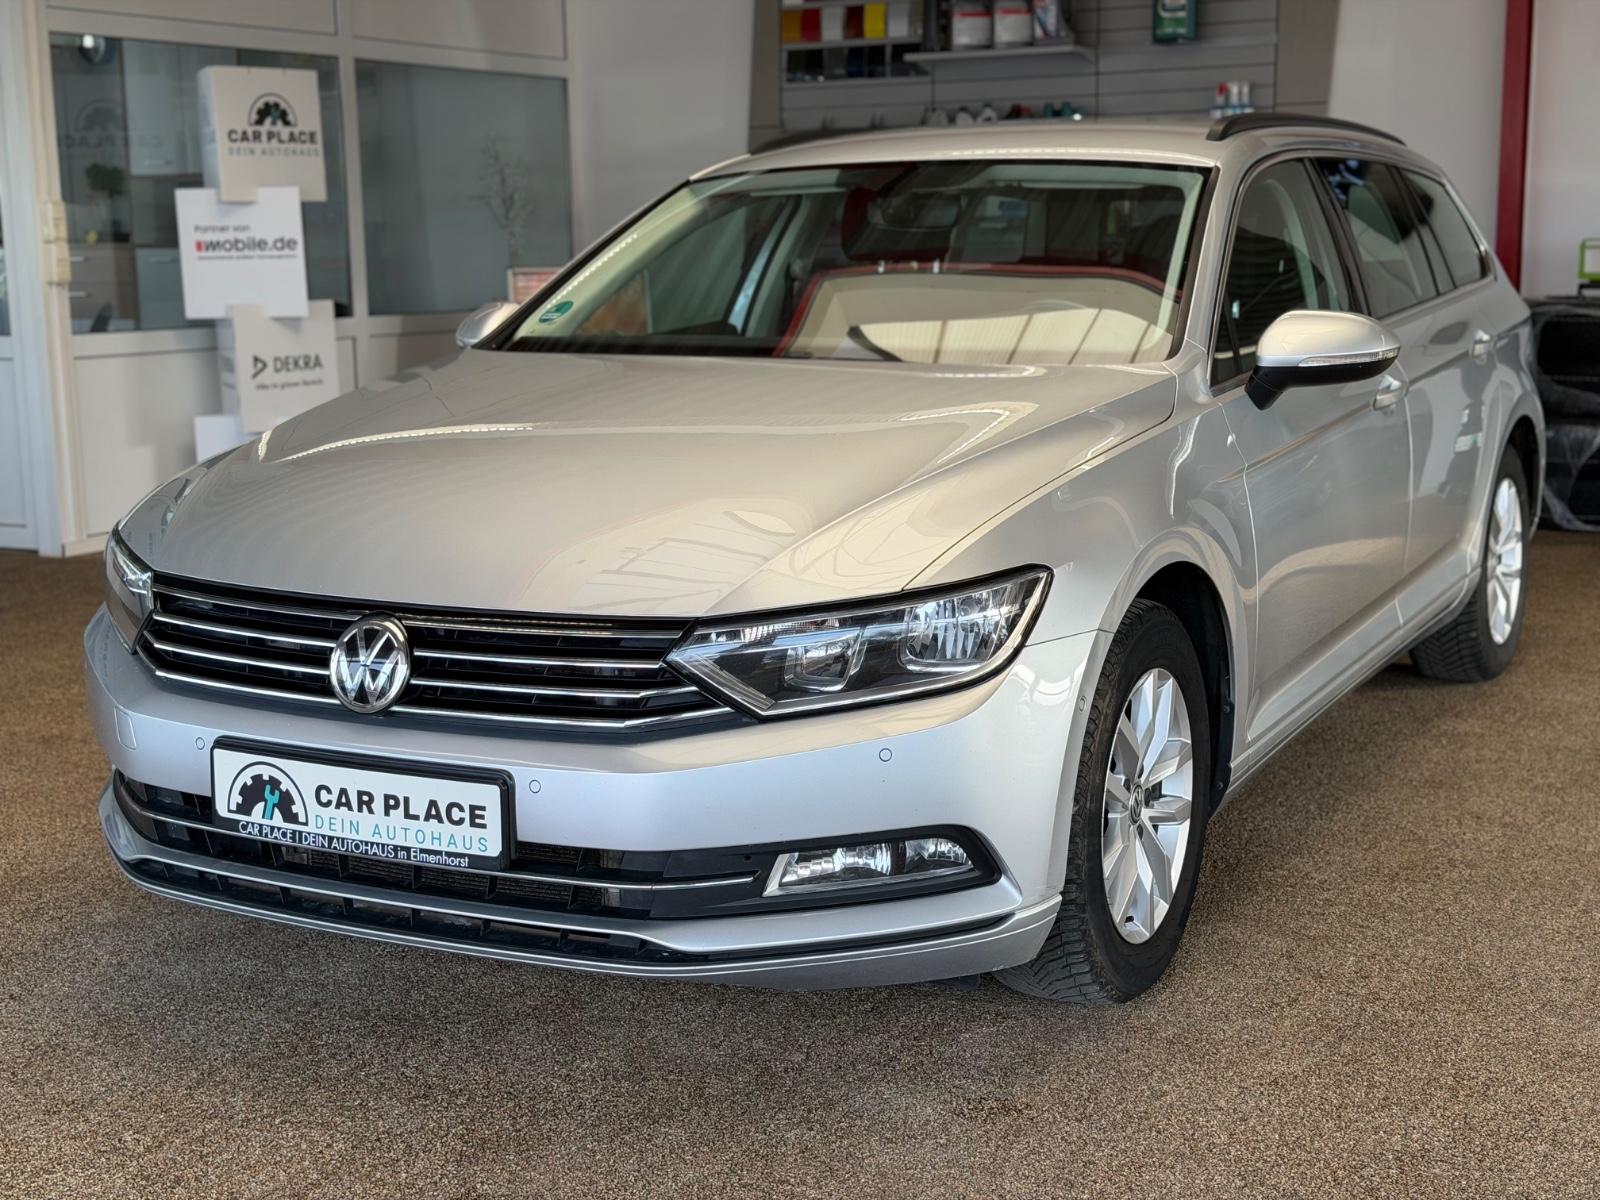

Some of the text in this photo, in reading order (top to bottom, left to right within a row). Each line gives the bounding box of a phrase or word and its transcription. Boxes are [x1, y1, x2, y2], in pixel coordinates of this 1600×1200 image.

[228, 129, 318, 144] CAR PLACE
[204, 236, 298, 253] mobile.de
[273, 354, 323, 373] DEKRA
[314, 784, 488, 829] CAR PLACE
[238, 821, 260, 836] CAR
[262, 825, 293, 842] PLACE
[302, 833, 329, 848] DEIN
[331, 838, 395, 857] AUTOHAUS
[397, 847, 407, 859] in
[410, 847, 469, 867] Elmenhorst
[315, 815, 488, 852] DEIN AUTOHAUS
